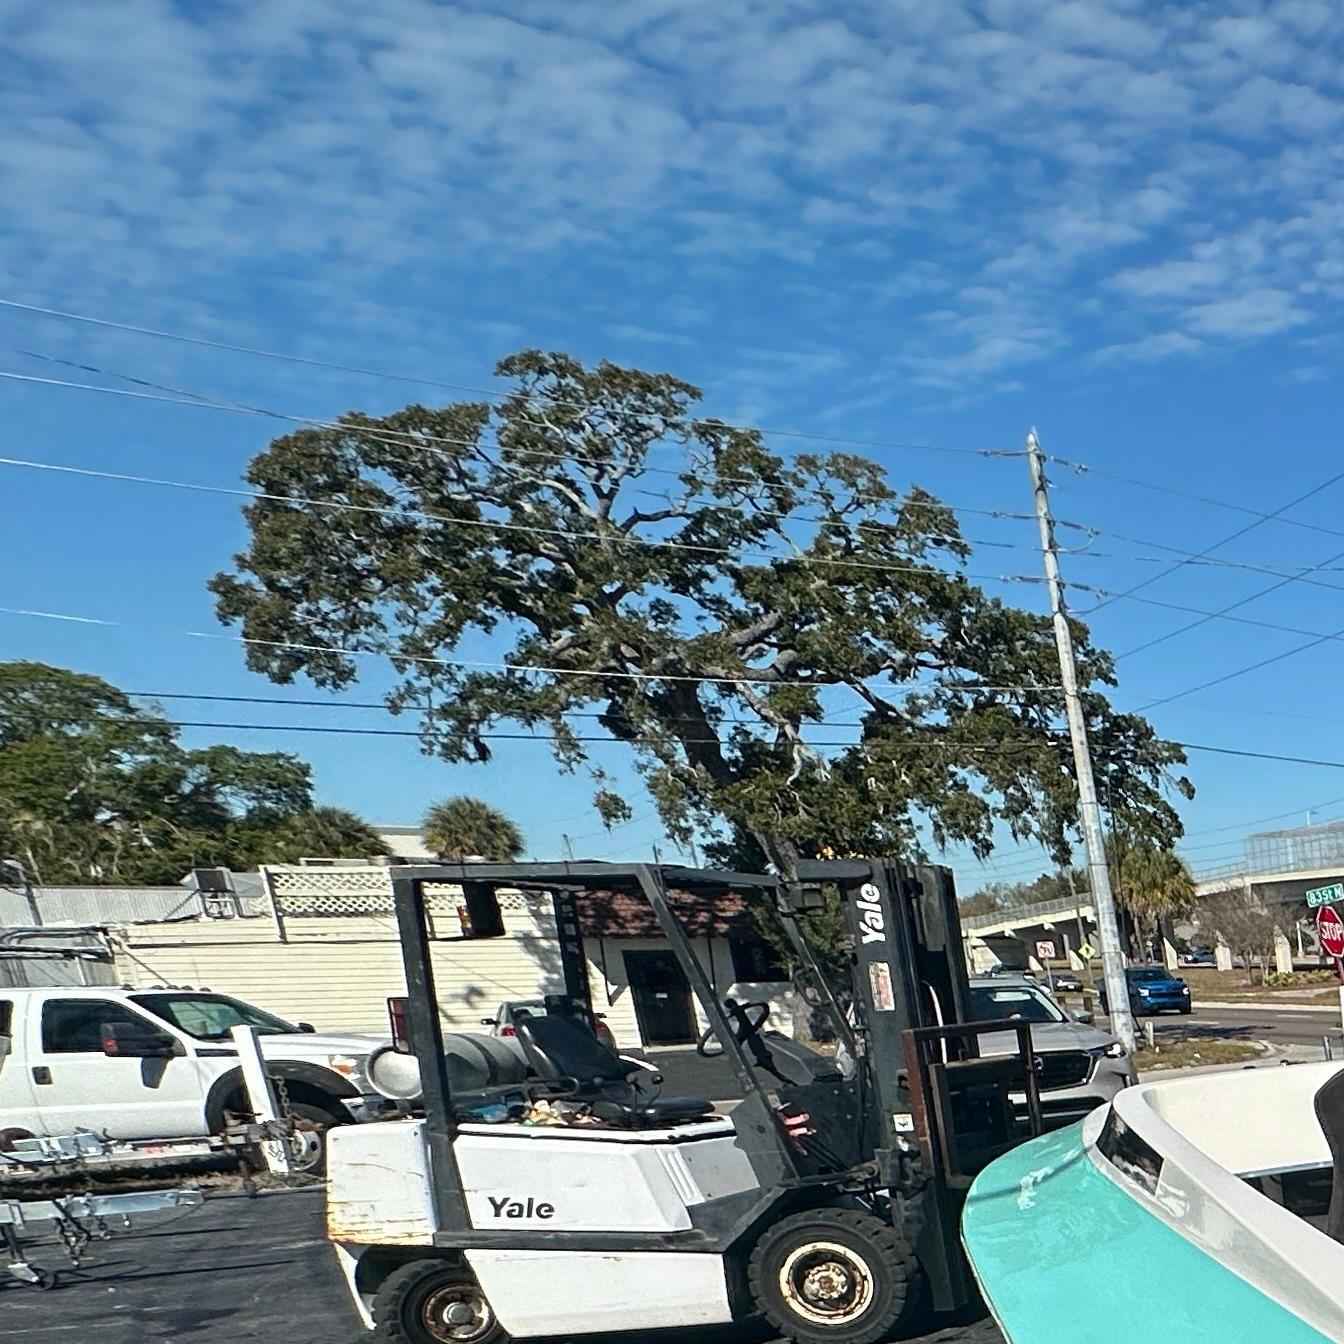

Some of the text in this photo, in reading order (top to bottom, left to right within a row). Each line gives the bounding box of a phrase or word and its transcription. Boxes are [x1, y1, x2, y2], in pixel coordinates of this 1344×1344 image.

[857, 883, 886, 944] Yale
[1320, 921, 1344, 941] STOP
[487, 1196, 555, 1219] Yale
